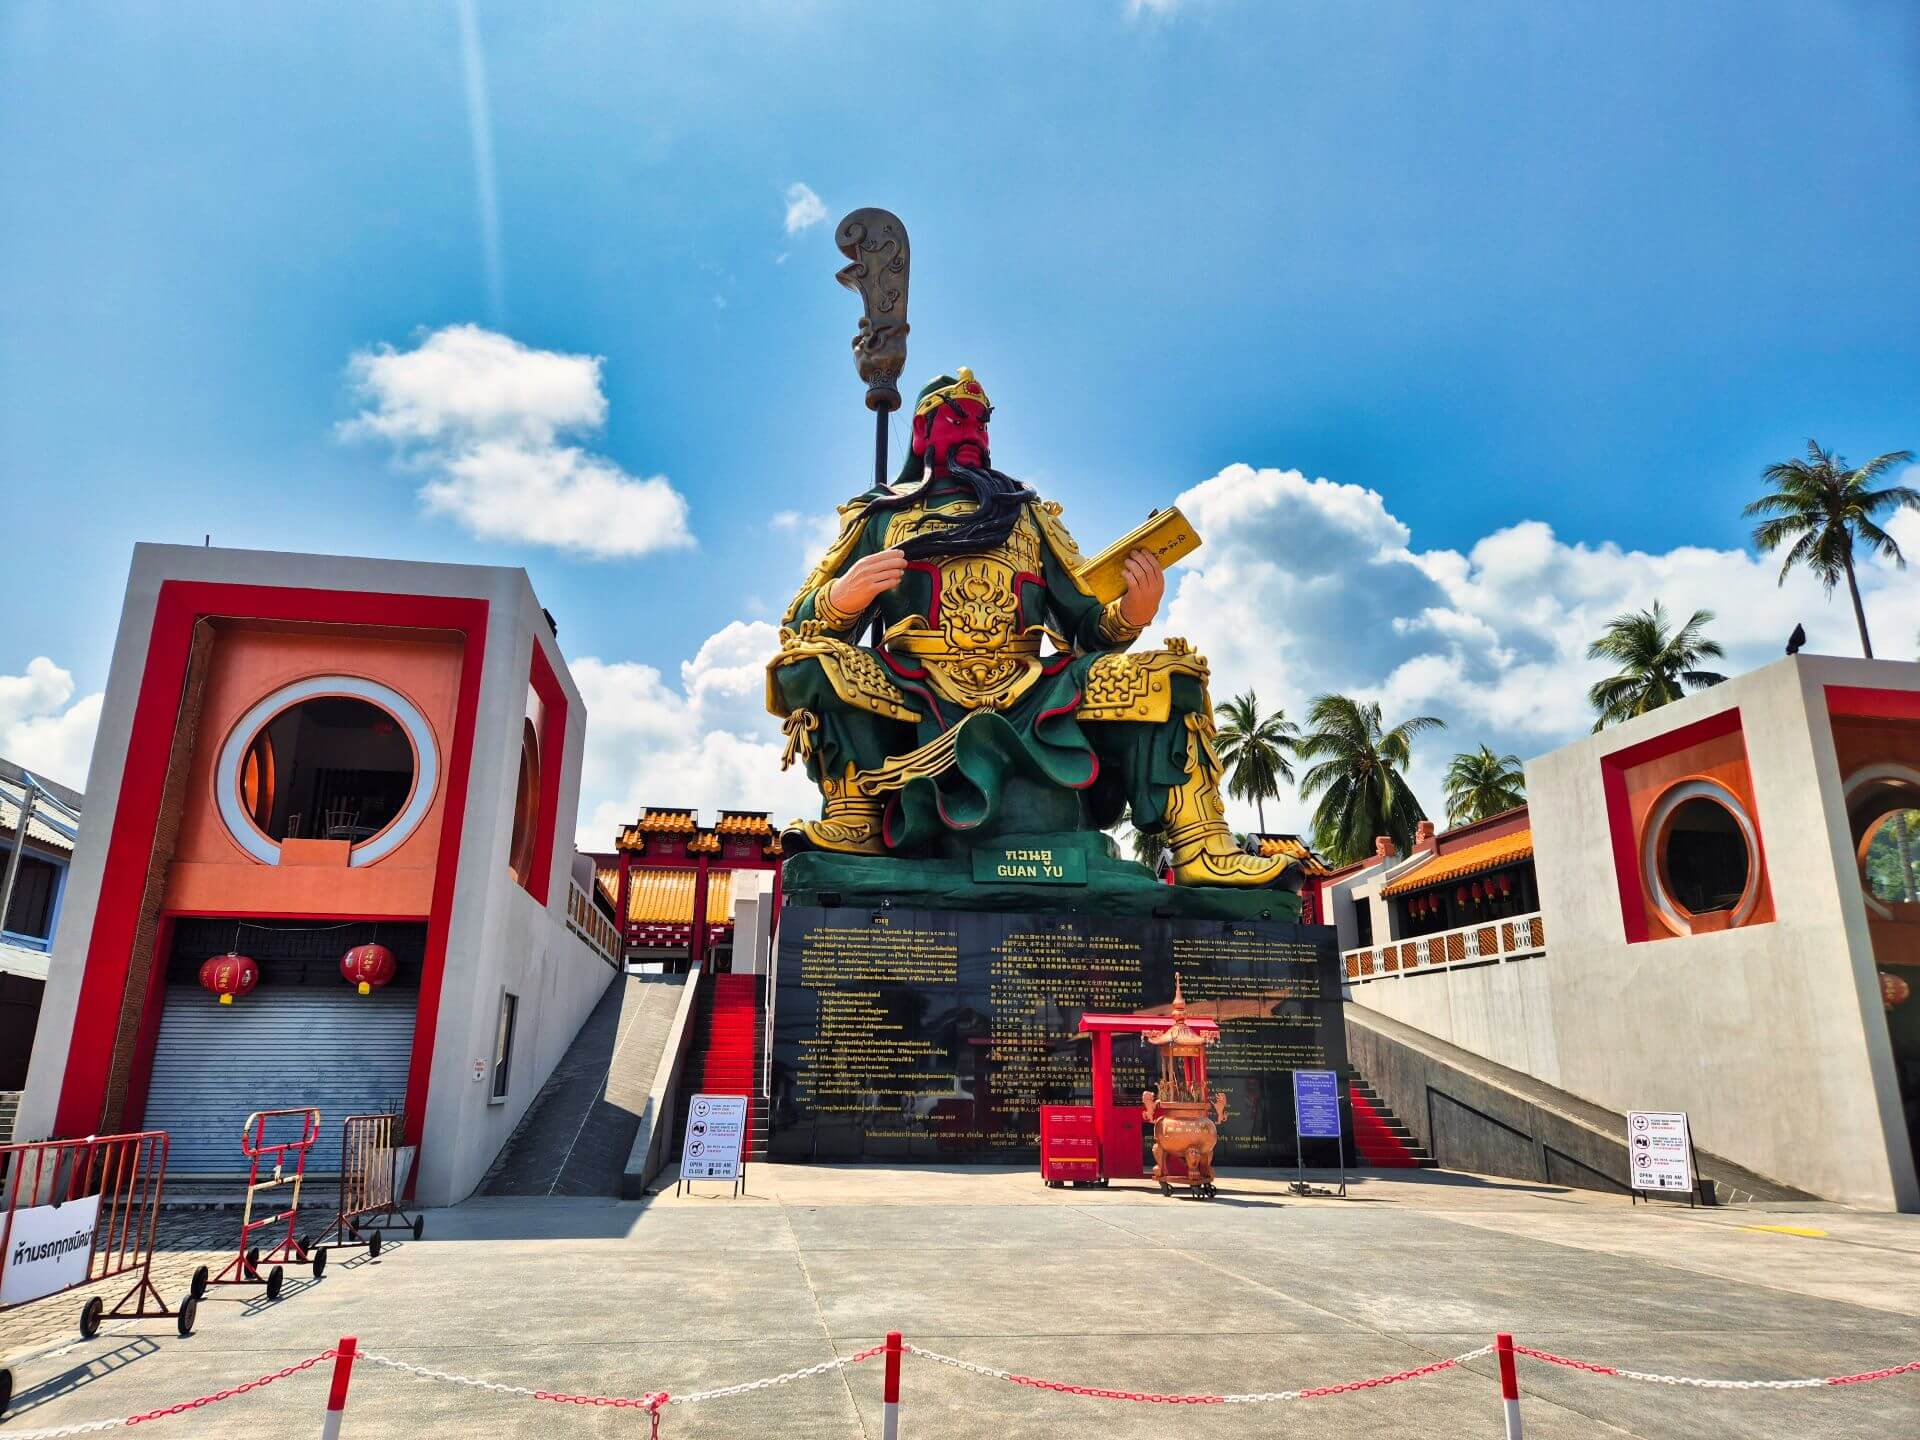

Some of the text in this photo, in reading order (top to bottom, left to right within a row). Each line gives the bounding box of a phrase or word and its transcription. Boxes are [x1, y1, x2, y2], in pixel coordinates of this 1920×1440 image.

[1005, 850, 1052, 866] กวนอู
[997, 864, 1063, 878] GUAN YU
